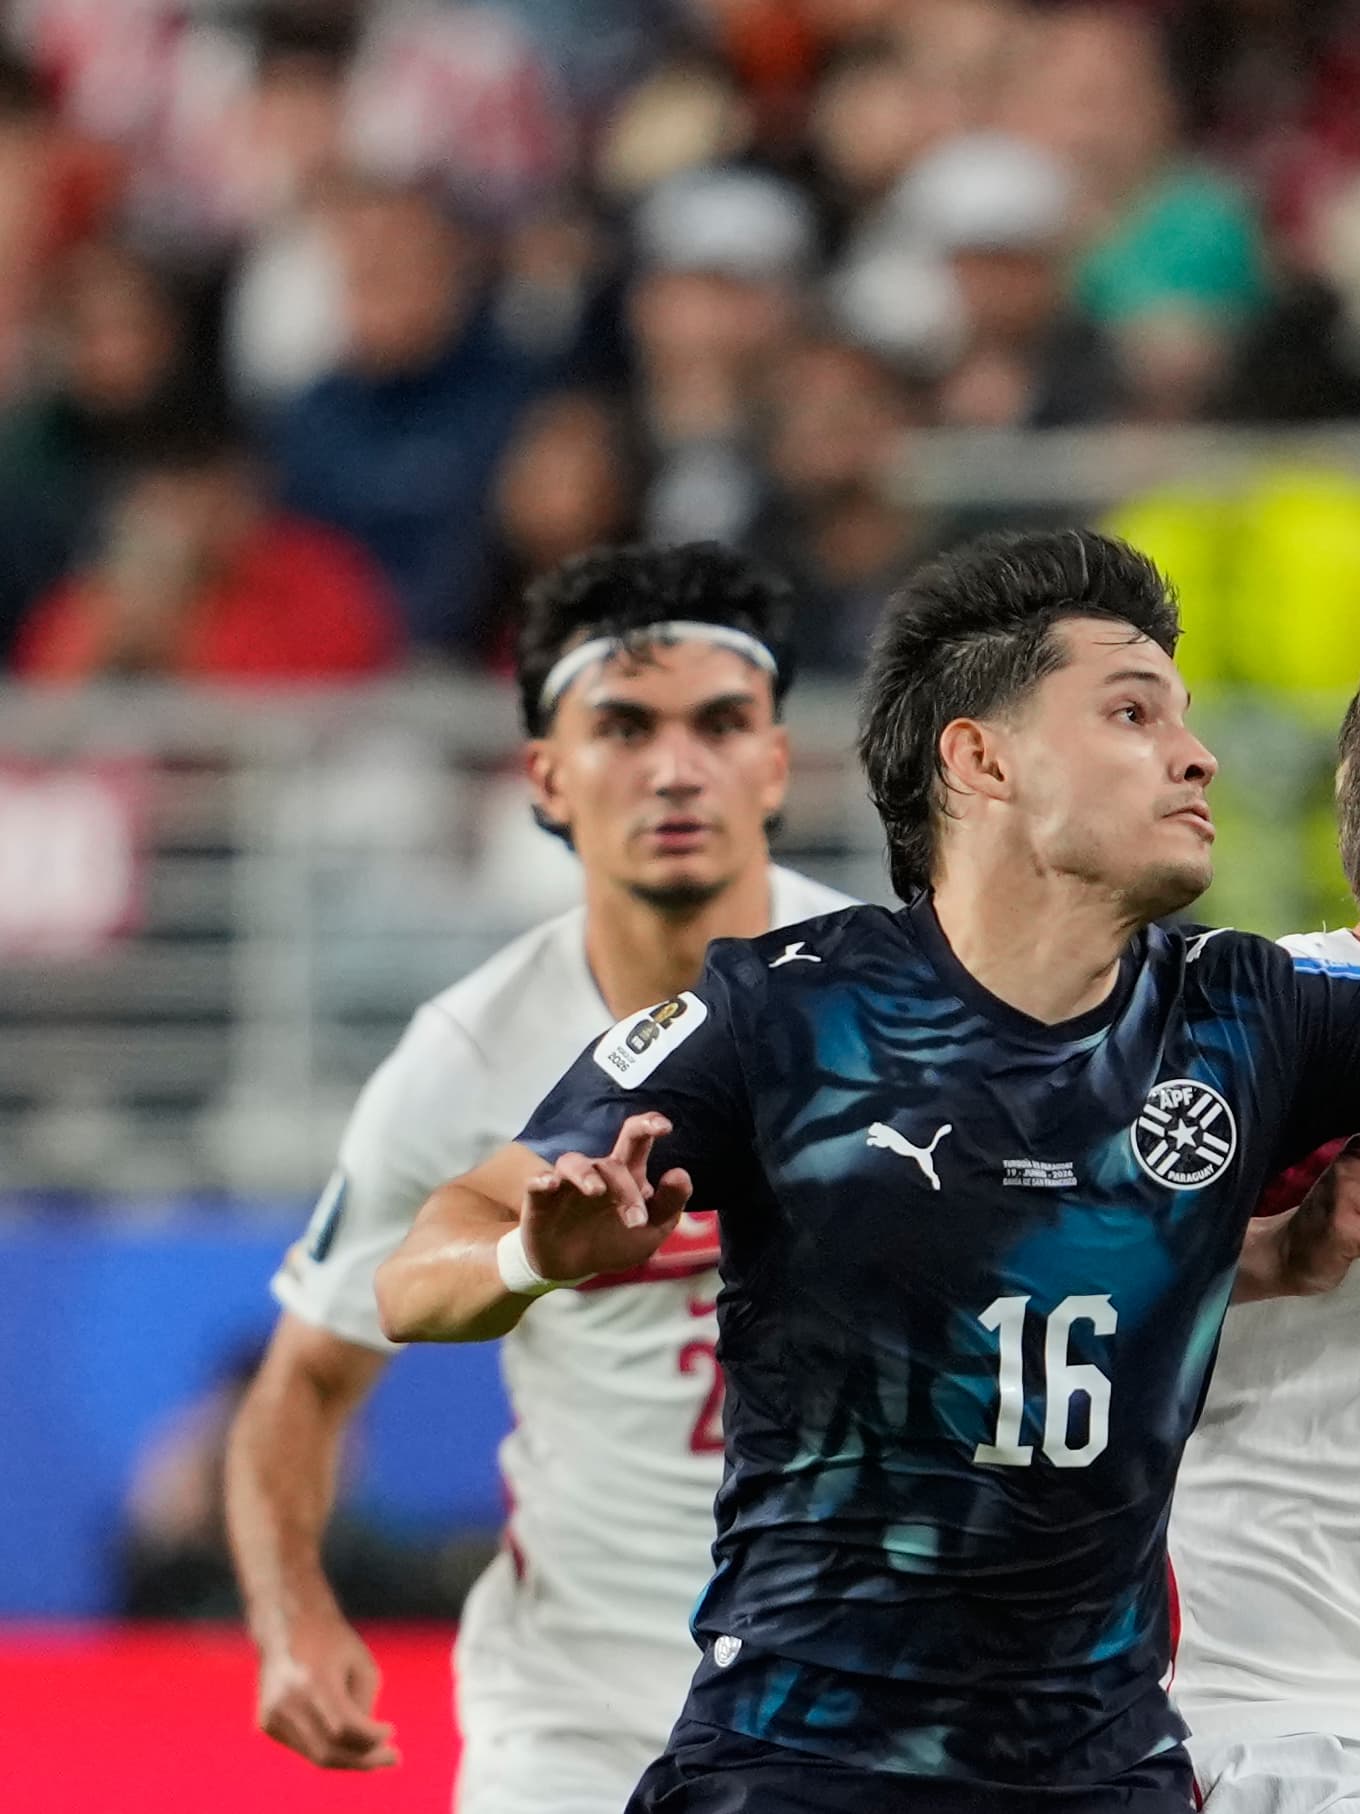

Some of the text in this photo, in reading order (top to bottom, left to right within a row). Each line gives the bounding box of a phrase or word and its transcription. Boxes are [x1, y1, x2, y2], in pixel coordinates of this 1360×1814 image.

[607, 1051, 630, 1072] 2026
[1160, 1087, 1194, 1110] APF
[1167, 1164, 1215, 1182] PARAGUAY
[972, 1294, 1118, 1468] 16
